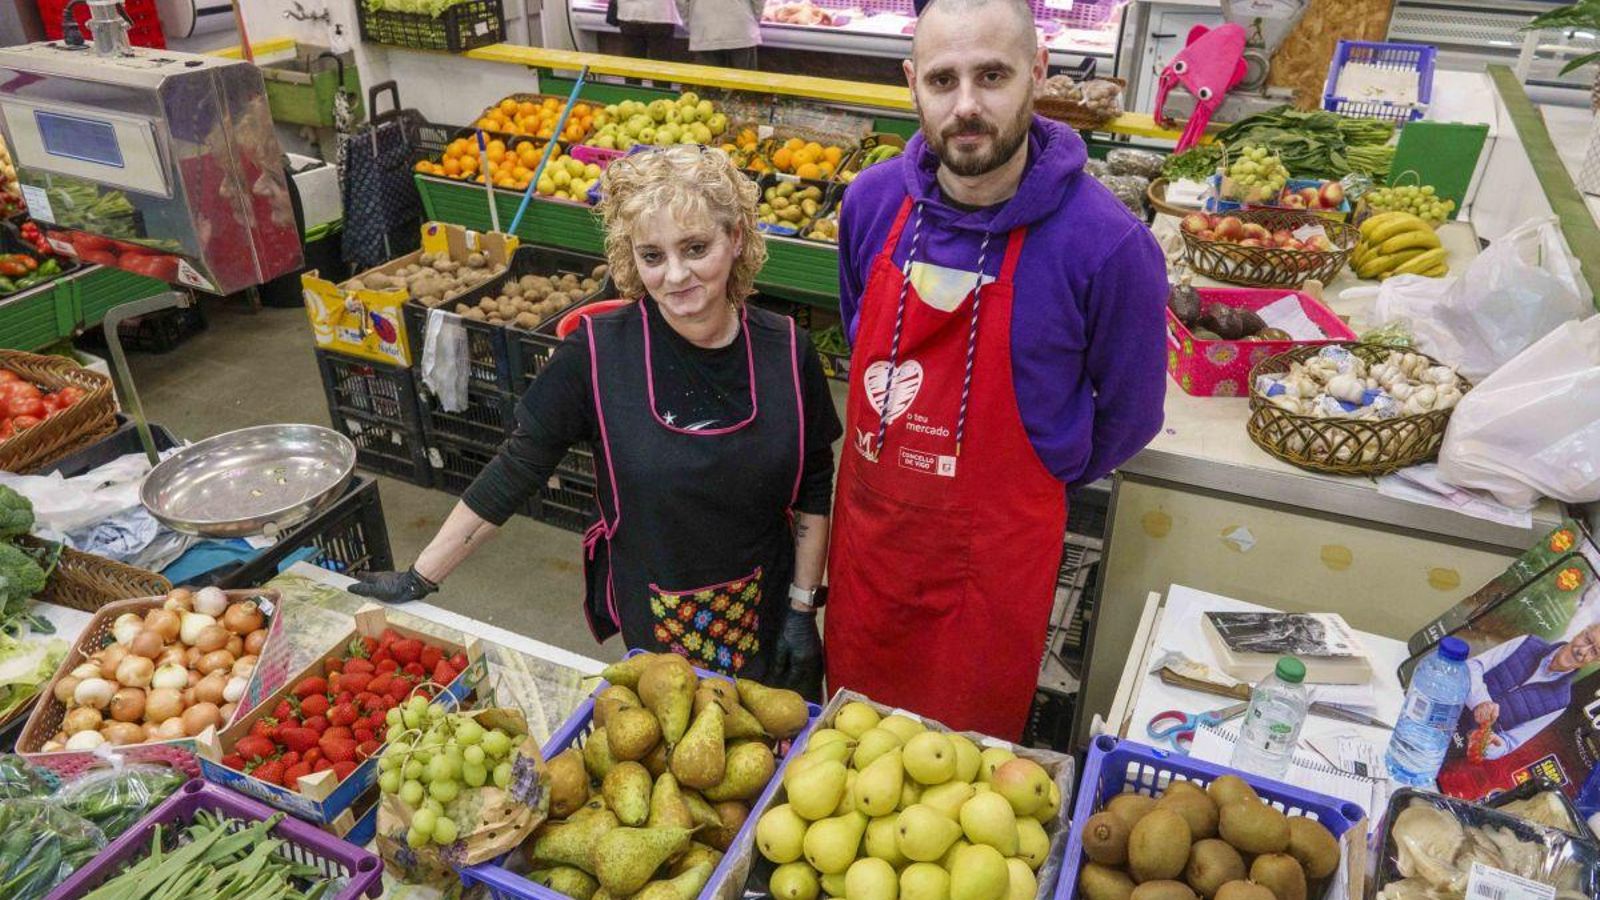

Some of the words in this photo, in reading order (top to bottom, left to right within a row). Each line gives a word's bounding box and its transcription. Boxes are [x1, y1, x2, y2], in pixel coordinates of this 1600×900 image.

[914, 413, 929, 423] teu
[906, 422, 950, 437] mercado
[902, 451, 935, 464] CONCELLO
[904, 458, 914, 467] DE
[914, 460, 930, 469] VIGO
